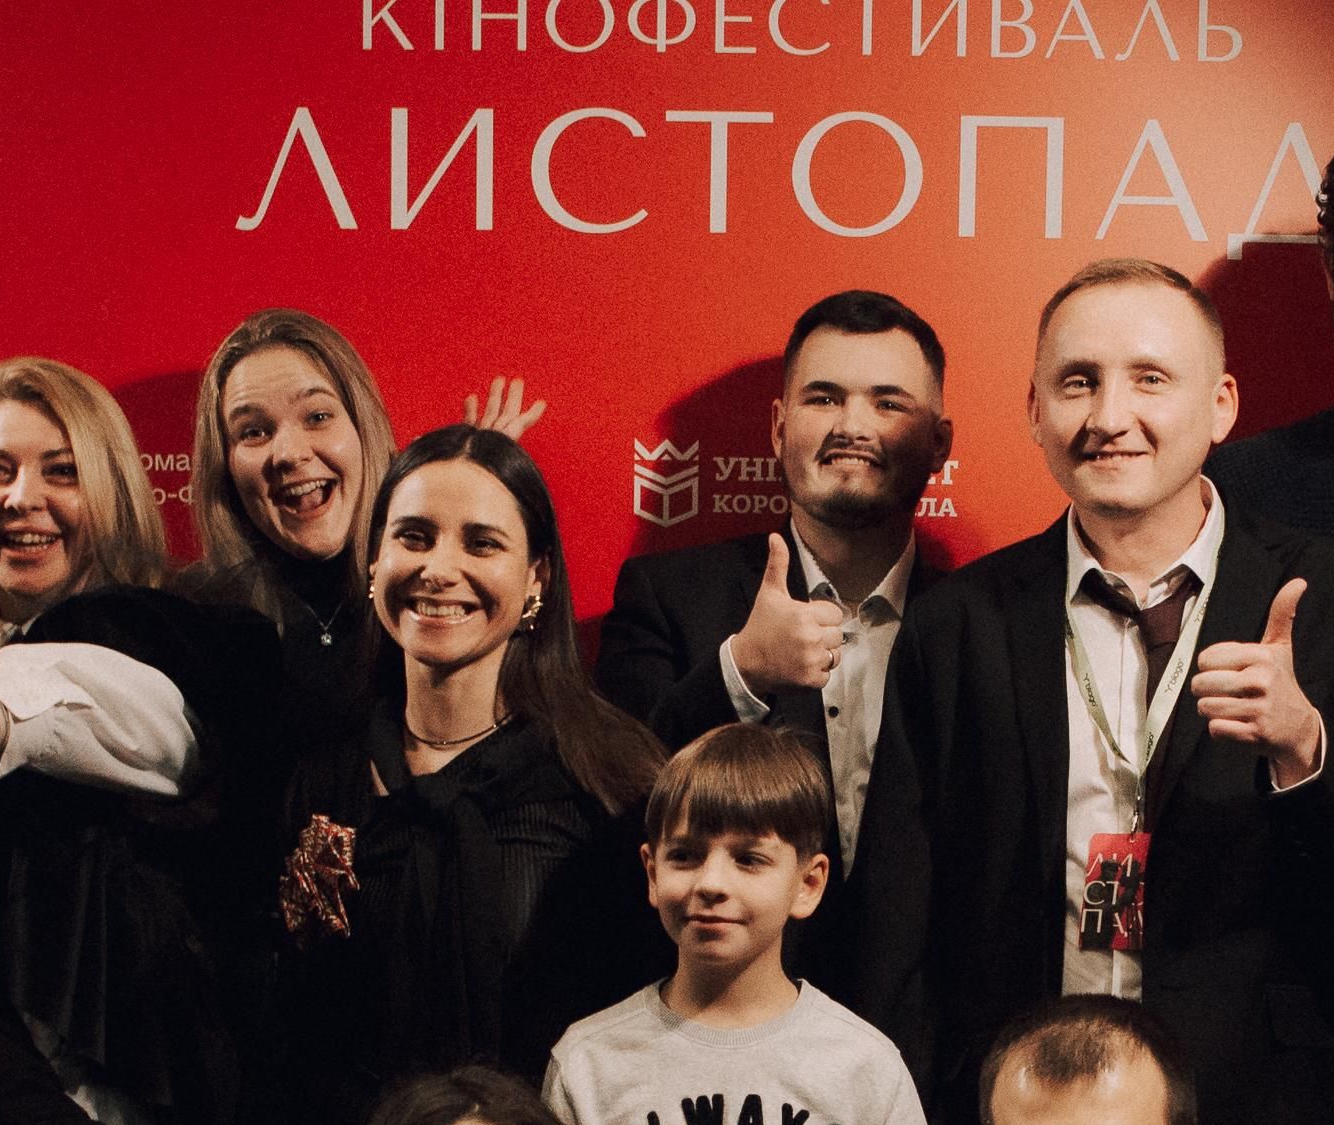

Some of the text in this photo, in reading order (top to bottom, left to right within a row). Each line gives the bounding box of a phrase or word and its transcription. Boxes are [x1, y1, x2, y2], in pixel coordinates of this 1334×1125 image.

[362, 0, 1244, 62] КІНОФЕСТИВАЛЬ
[235, 107, 1328, 260] ЛИСТОПАД
[712, 494, 792, 515] КОРО
